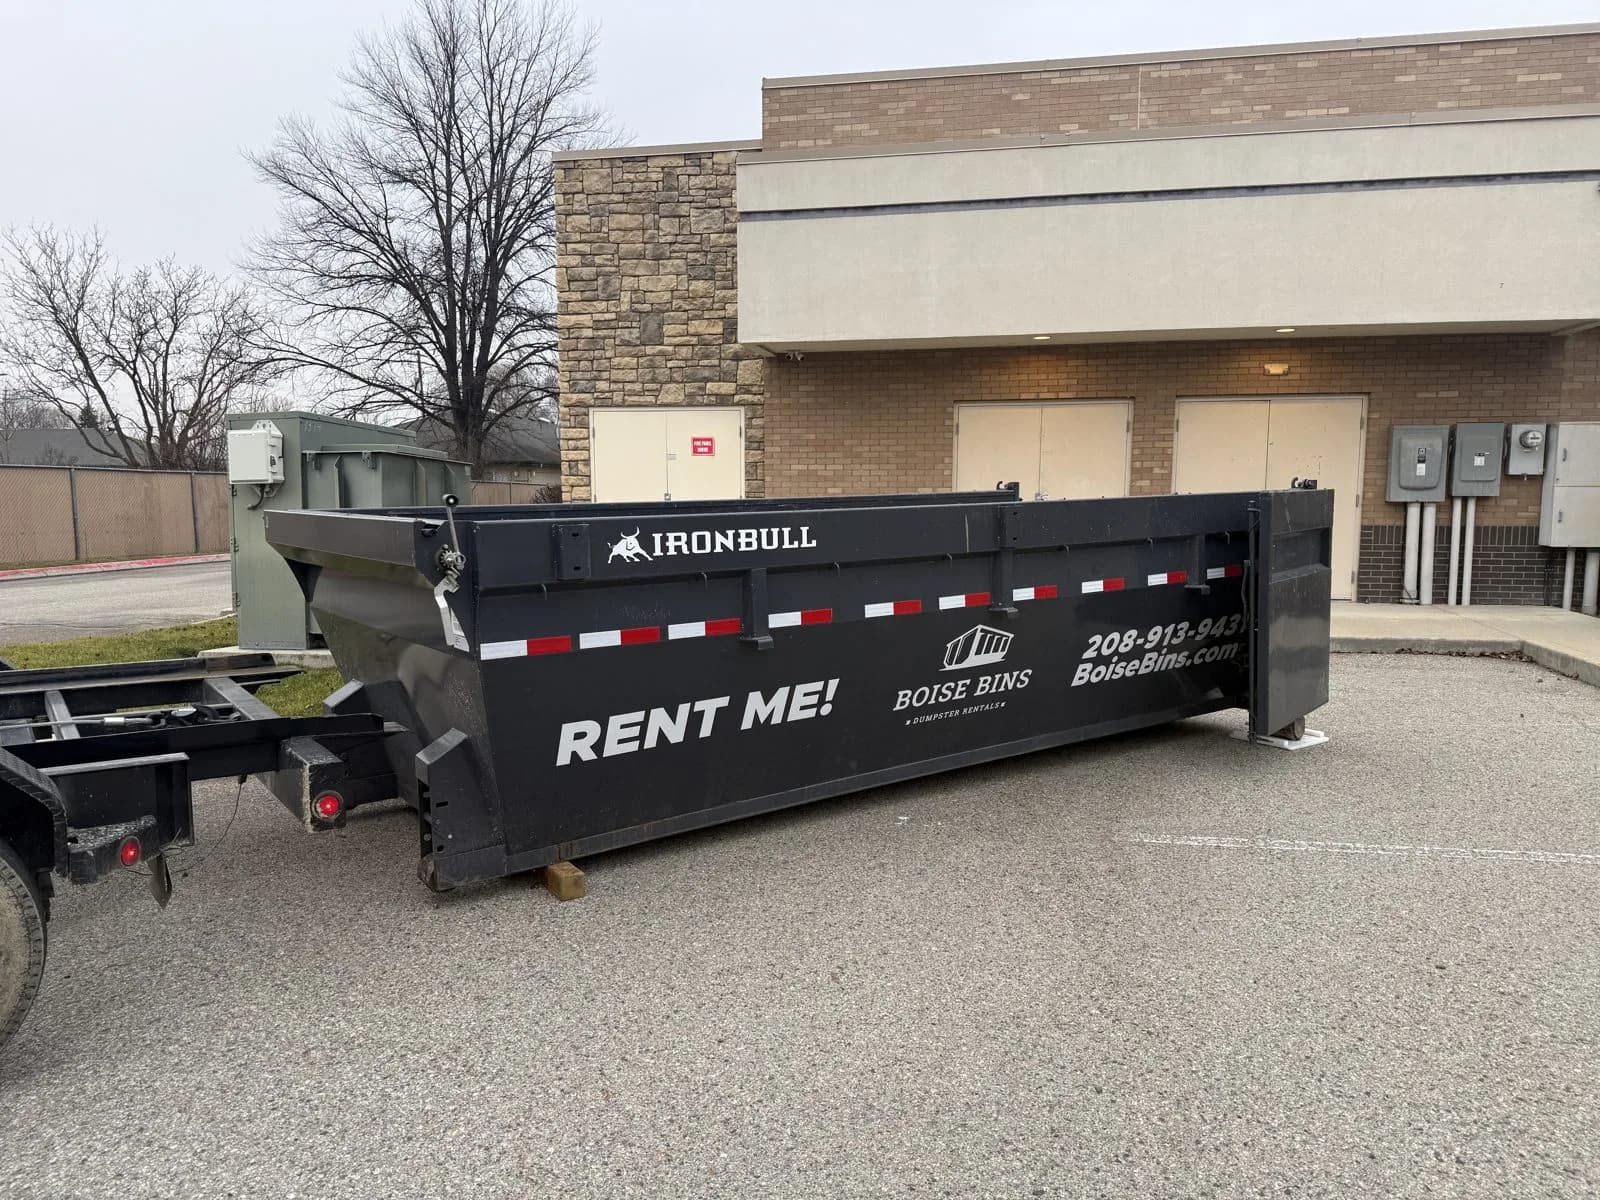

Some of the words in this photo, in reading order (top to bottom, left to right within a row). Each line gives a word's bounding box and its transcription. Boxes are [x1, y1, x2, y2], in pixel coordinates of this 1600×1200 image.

[653, 527, 817, 556] IRONBULL
[1071, 643, 1238, 687] BoiseBins.com
[893, 679, 971, 711] BOISE
[974, 669, 1033, 696] BINS
[556, 696, 730, 766] RENT
[741, 678, 840, 730] ME!
[913, 709, 960, 725] DUMPSTER
[962, 702, 1000, 715] RENTALS
